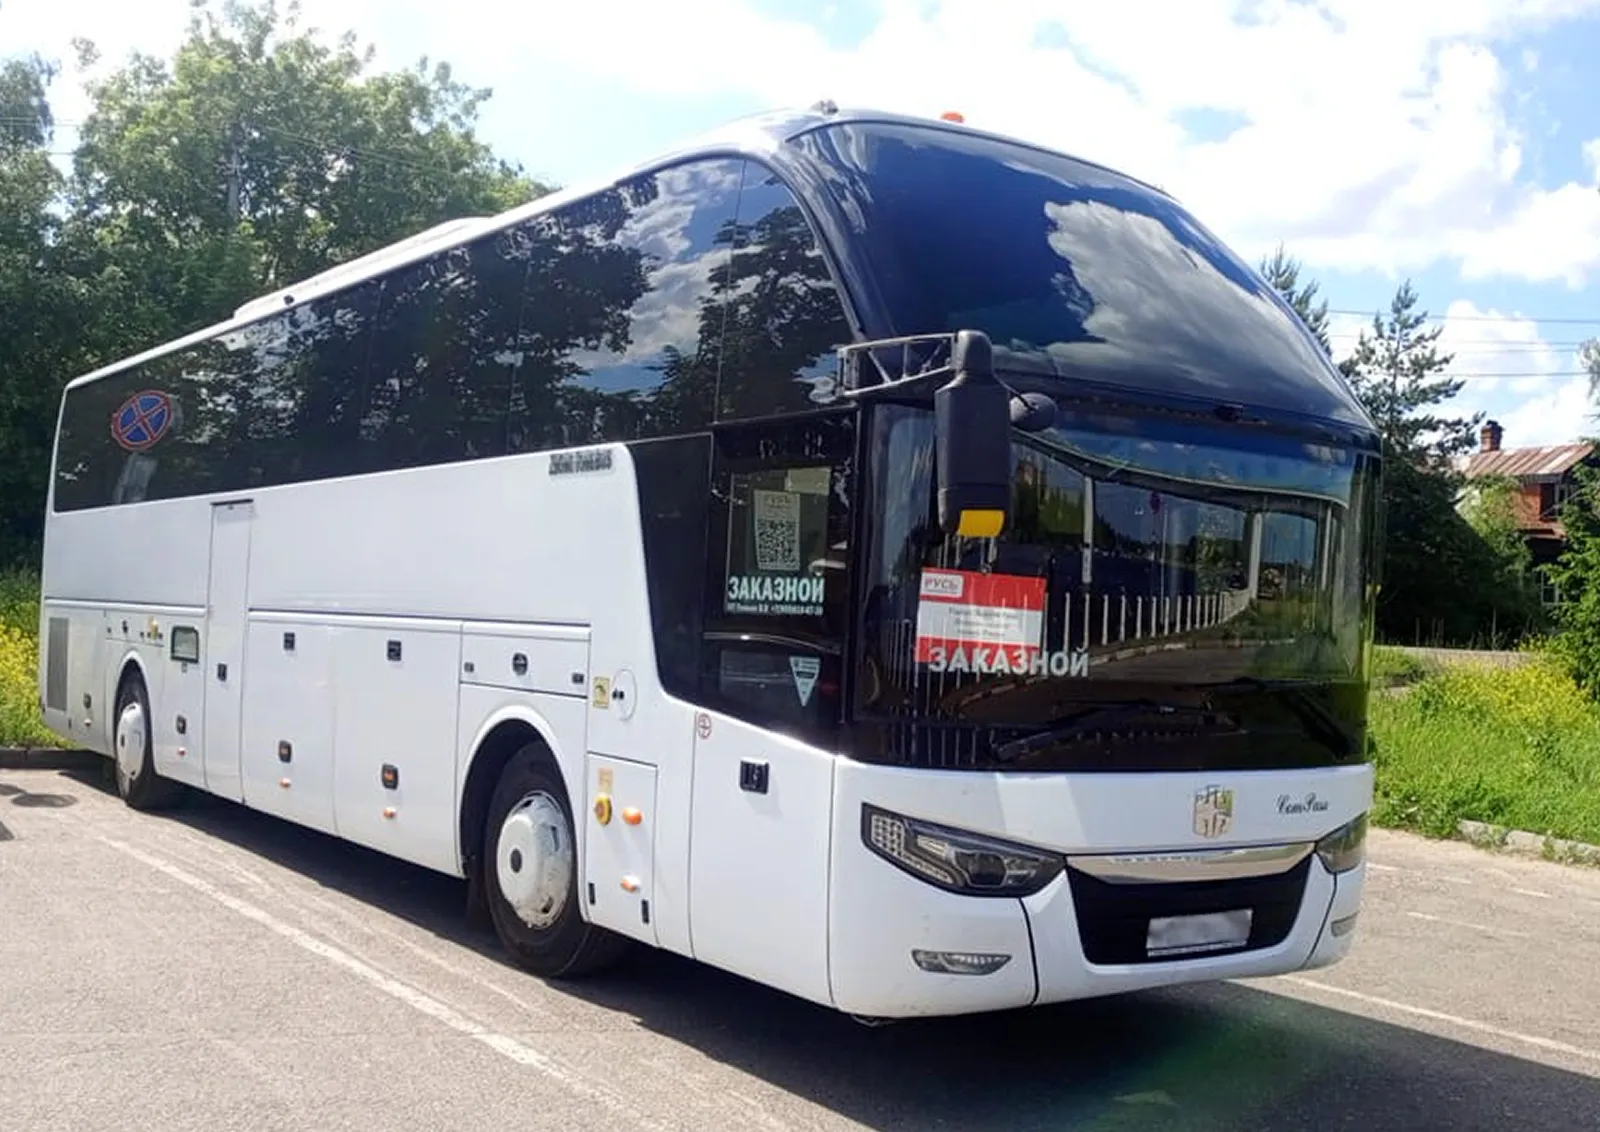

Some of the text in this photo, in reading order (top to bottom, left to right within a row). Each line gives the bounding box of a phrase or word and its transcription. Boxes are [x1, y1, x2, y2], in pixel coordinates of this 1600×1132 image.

[728, 571, 825, 603] ЗАКАЗНОЙ
[924, 577, 957, 590] РУСЬ
[928, 646, 1089, 678] ЗАКАЗНОЙ
